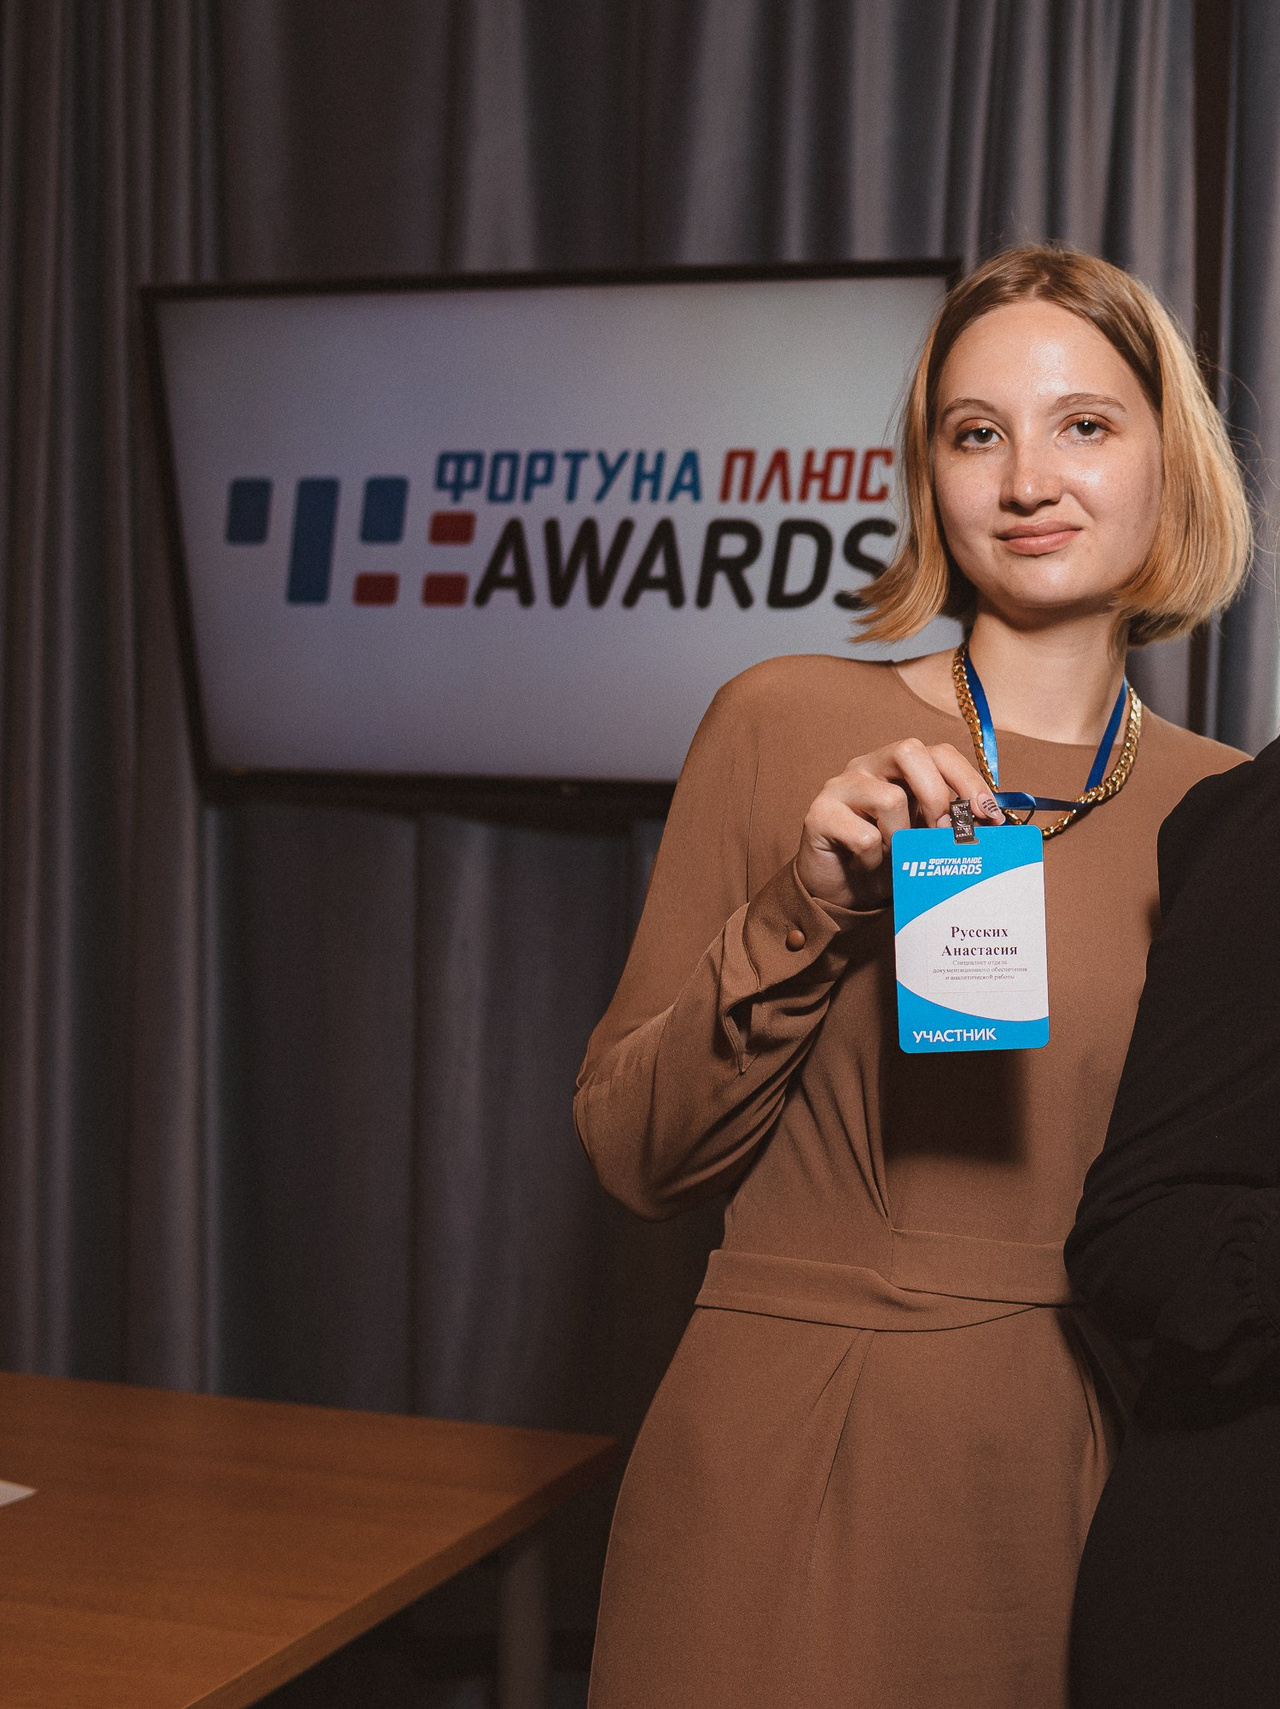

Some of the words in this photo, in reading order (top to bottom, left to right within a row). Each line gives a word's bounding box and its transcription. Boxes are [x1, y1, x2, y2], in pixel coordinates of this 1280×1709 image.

[434, 449, 701, 503] ФОРТУНА
[719, 446, 894, 502] ПЛЮС
[473, 516, 898, 610] AWARDS
[928, 857, 961, 865] ФОРТУНА
[933, 863, 982, 876] AWARDS
[951, 926, 1008, 941] Русских
[941, 944, 1017, 956] Анастасия
[912, 1028, 997, 1043] УЧАСТНИК
